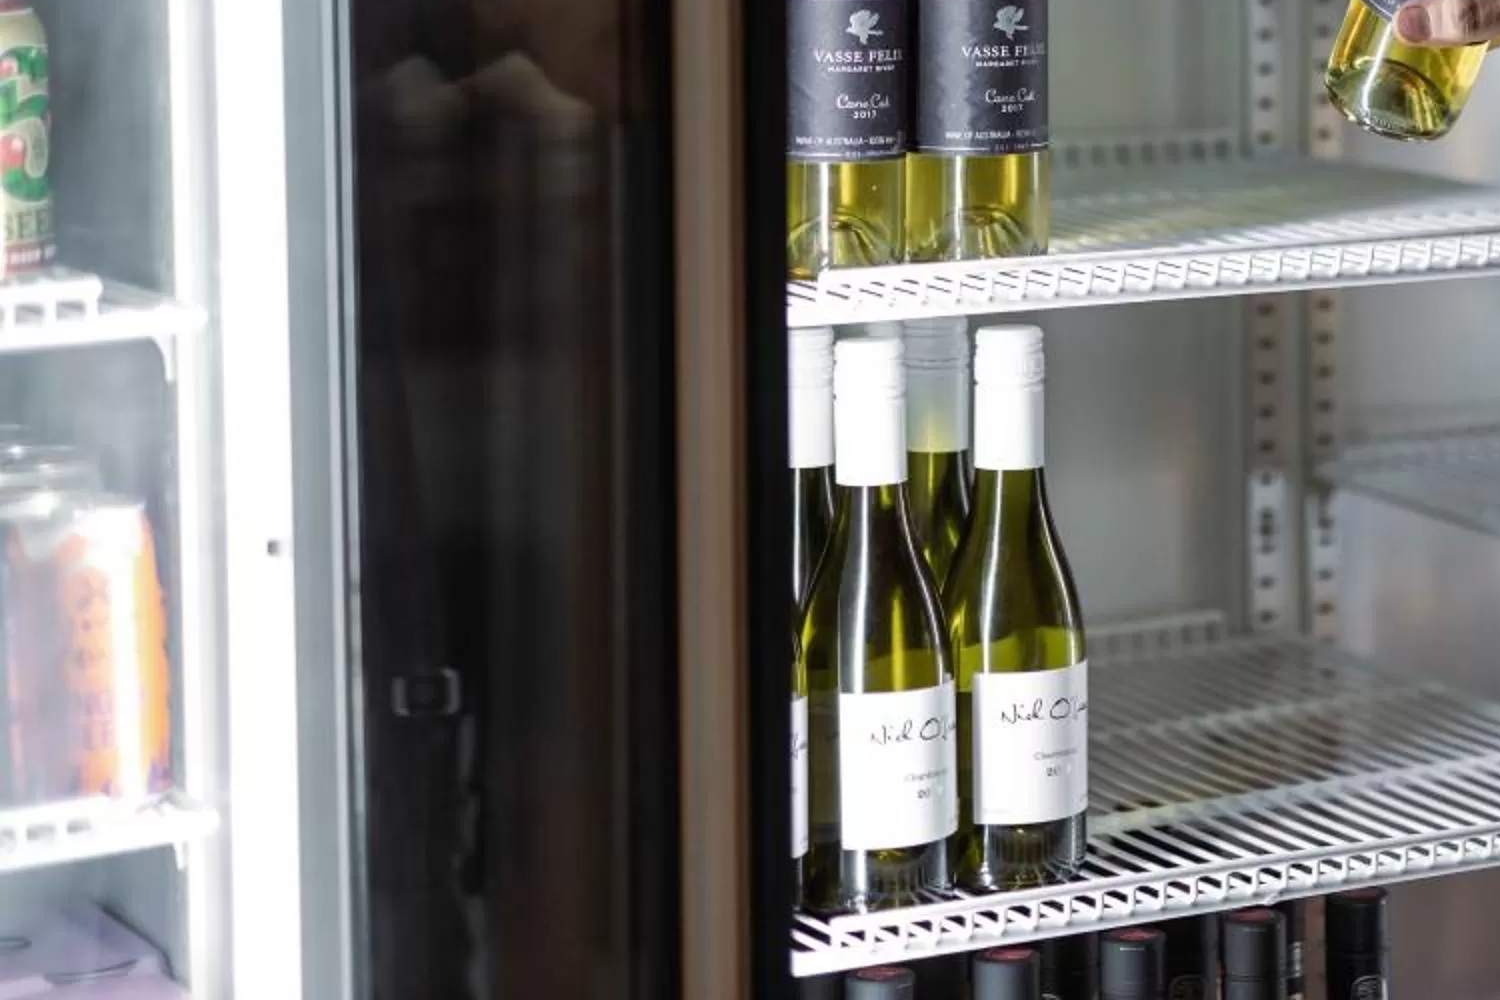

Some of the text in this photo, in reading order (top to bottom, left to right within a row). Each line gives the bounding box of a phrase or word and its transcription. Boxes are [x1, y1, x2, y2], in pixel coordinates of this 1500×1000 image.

[814, 49, 865, 63] VASSE
[961, 44, 1011, 58] VASSE
[853, 110, 877, 120] 2017
